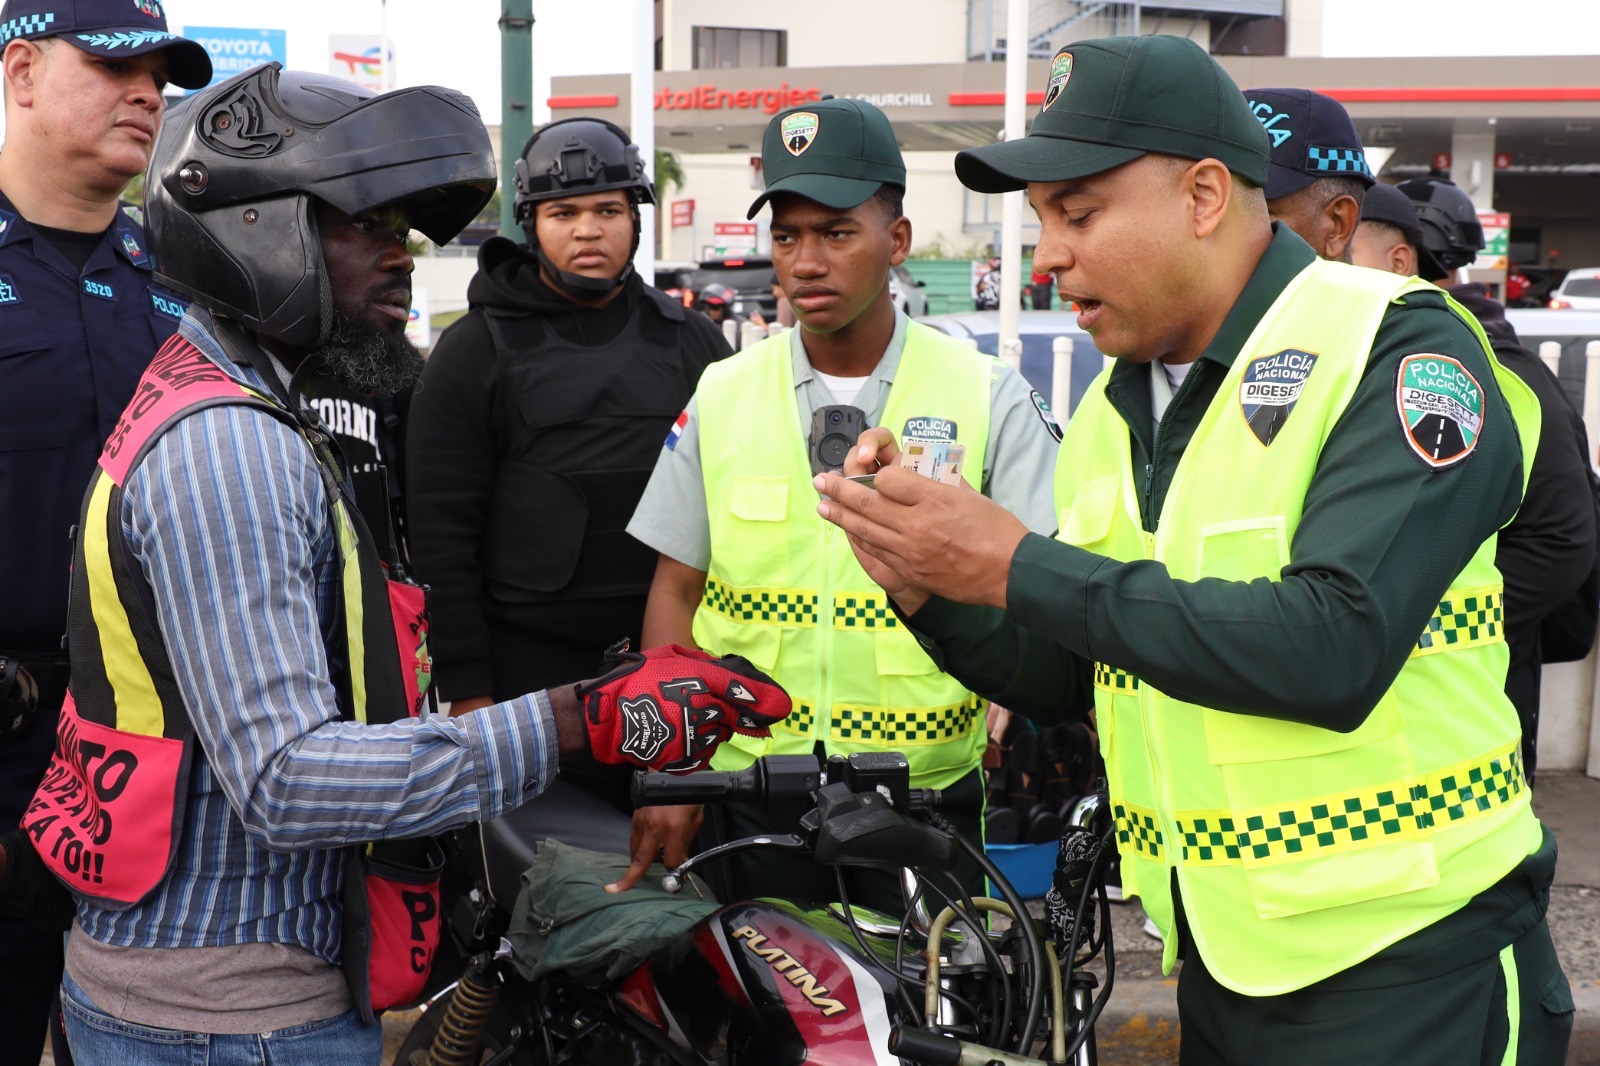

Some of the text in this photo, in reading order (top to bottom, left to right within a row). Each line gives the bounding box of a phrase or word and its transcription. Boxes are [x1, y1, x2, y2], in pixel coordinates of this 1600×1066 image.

[196, 38, 273, 56] TOYOTA
[84, 280, 113, 298] 3520
[1255, 354, 1314, 374] POLICÍA
[1418, 377, 1471, 408] NACIONAL
[1410, 390, 1474, 420] DIGESETT
[908, 420, 951, 433] POLICÍA
[912, 430, 950, 440] NACIONAL
[731, 924, 848, 1017] PLATINA
